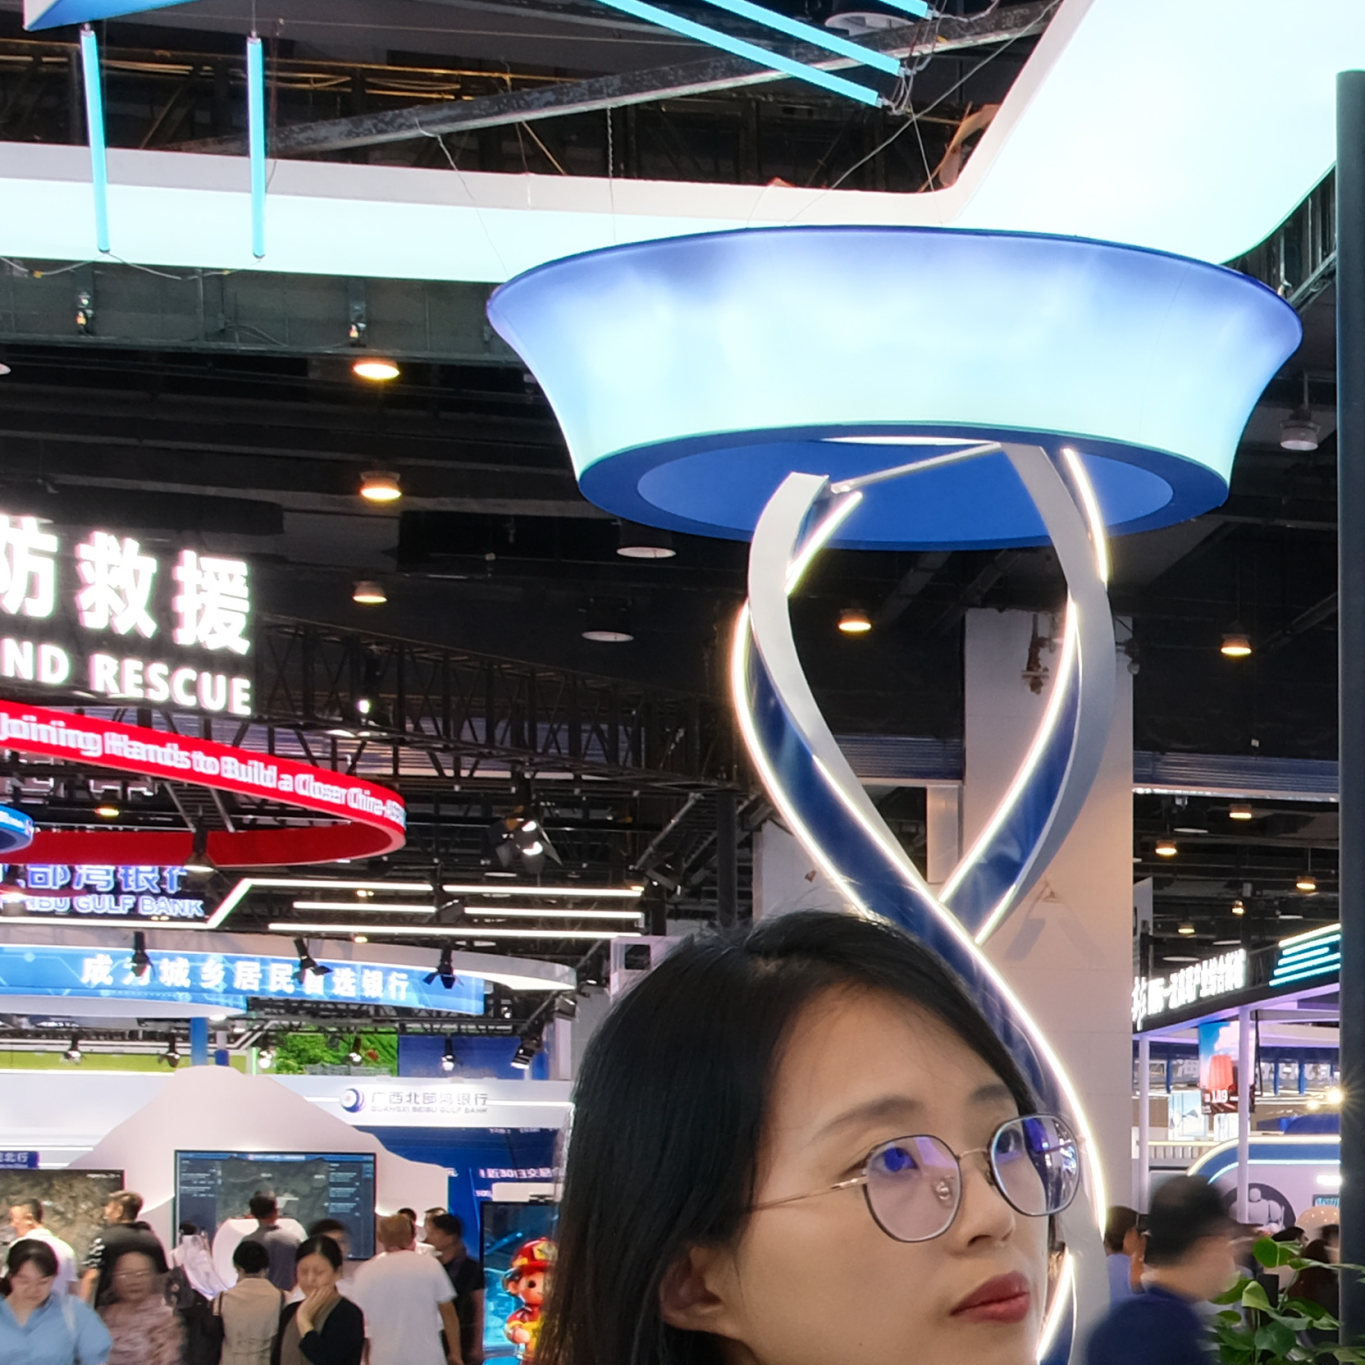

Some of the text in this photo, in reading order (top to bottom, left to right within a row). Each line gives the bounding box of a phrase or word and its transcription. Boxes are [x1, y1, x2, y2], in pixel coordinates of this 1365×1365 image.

[88, 653, 252, 716] RESCUE
[74, 895, 136, 915] GULF
[138, 897, 206, 917] BANK
